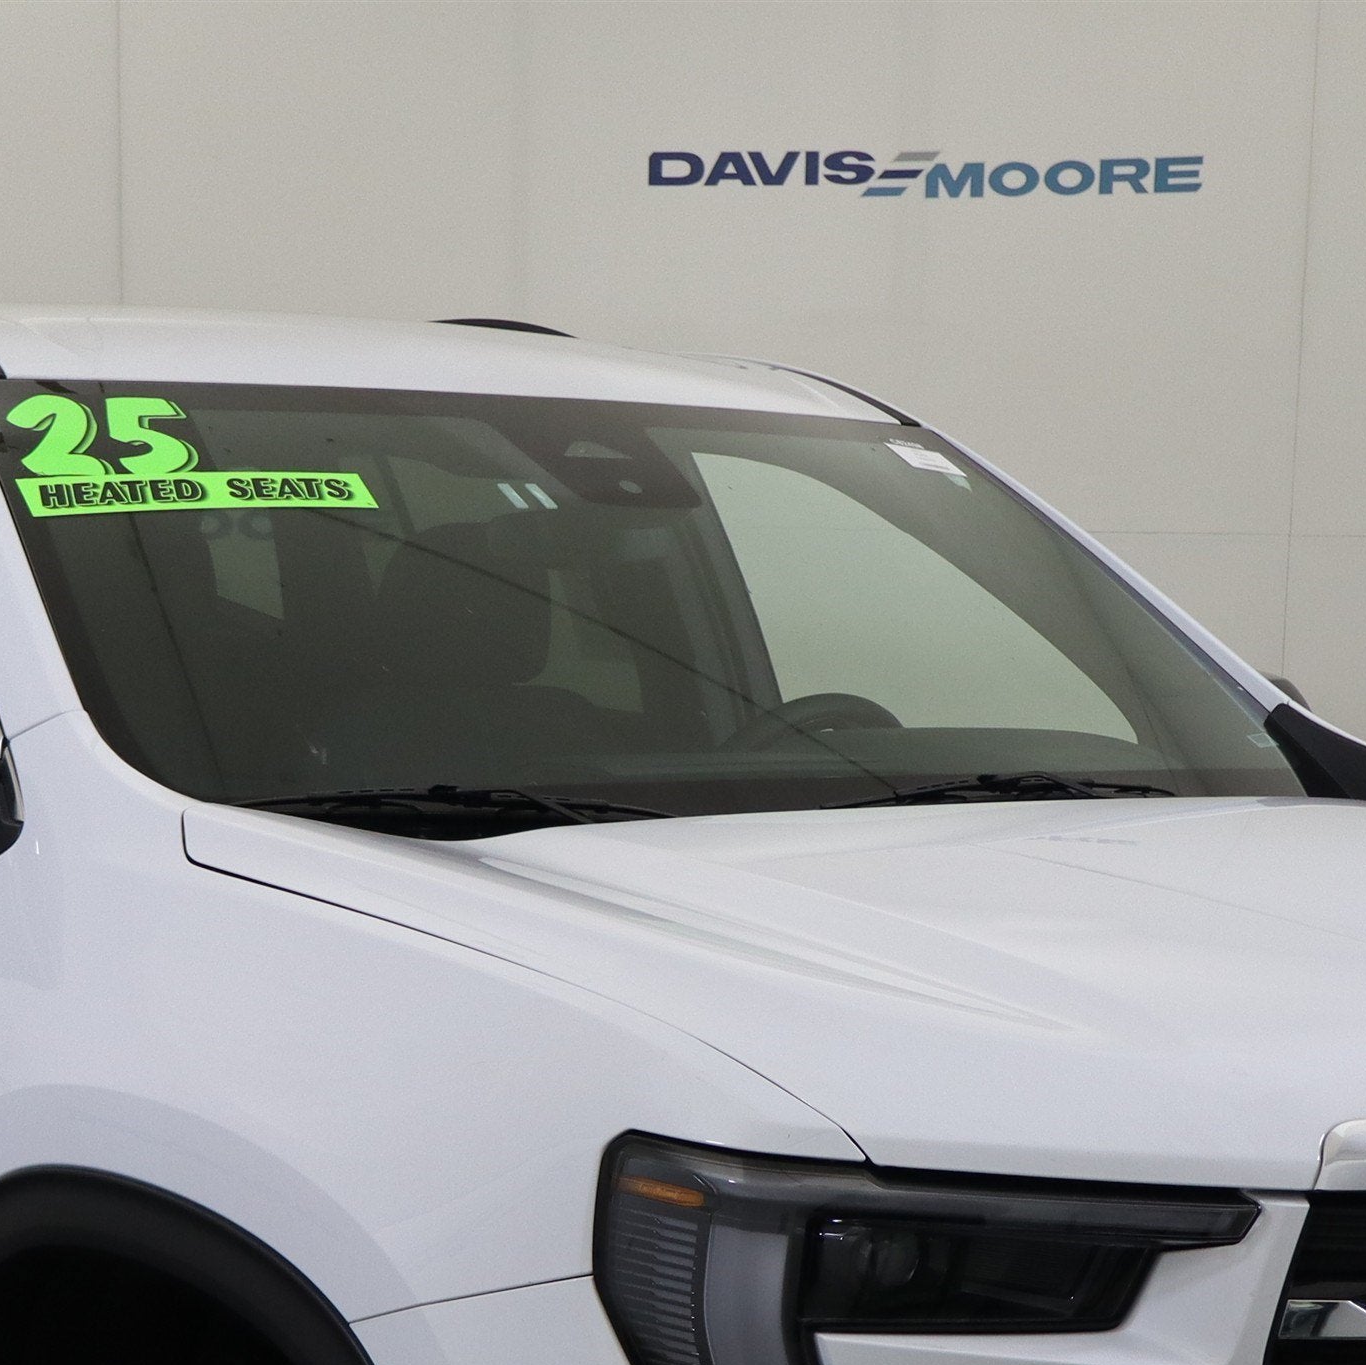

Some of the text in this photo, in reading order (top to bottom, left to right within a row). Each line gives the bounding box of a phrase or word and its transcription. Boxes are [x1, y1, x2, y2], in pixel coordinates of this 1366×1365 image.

[647, 150, 1205, 199] DAVIS MOORE
[6, 394, 199, 476] 25
[38, 476, 353, 508] HEATED SEATS
